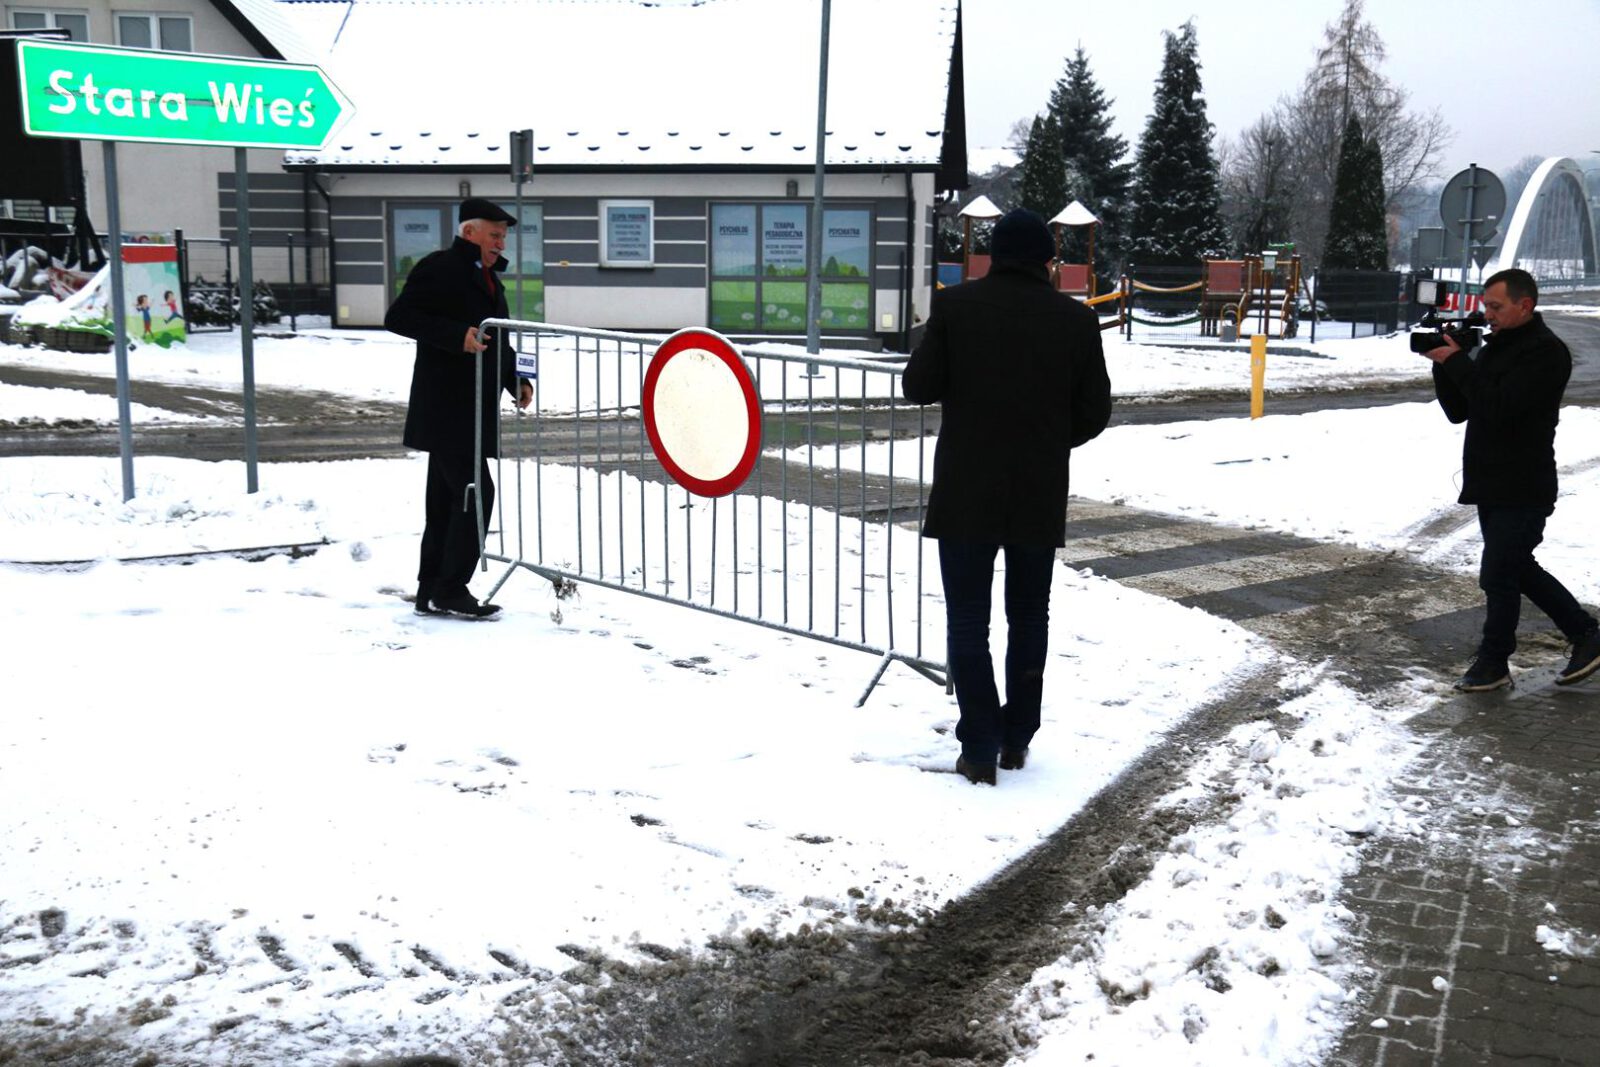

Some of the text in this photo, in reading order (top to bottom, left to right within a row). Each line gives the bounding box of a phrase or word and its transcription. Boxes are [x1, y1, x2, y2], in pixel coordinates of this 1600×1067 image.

[48, 69, 316, 128] Stara Wieś
[719, 225, 749, 234] PSYCHOLOG
